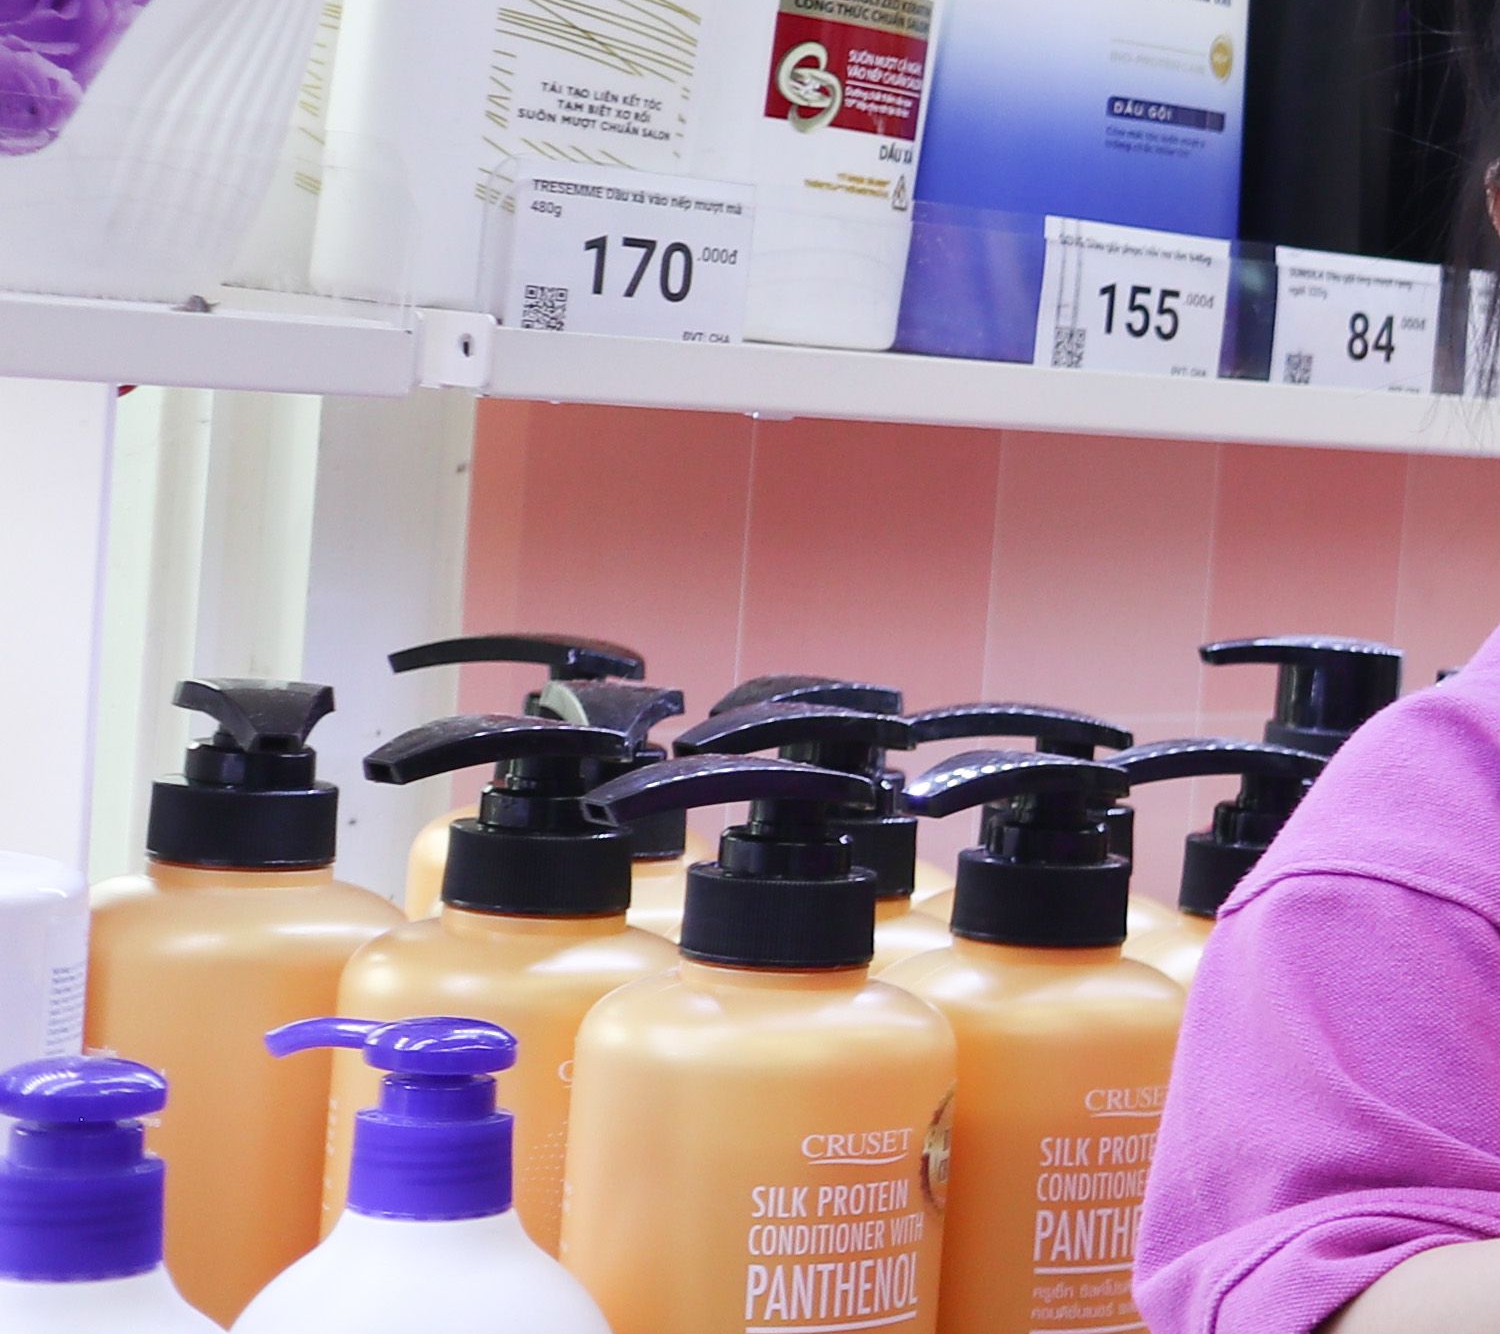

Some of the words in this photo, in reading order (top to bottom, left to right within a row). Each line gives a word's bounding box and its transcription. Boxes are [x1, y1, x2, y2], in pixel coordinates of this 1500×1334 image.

[540, 80, 563, 95] TÁI
[593, 89, 619, 105] LIÊN
[621, 93, 642, 109] KẾT
[642, 96, 663, 112] TÓC
[516, 105, 557, 125] SUÔN
[599, 118, 641, 138] CHUẨN
[640, 127, 672, 142] SALON
[532, 178, 605, 199] TRESEMME
[530, 199, 563, 219] 480g
[582, 233, 694, 303] 170
[696, 245, 739, 266] .000đ
[1098, 282, 1181, 342] 155
[1345, 310, 1396, 364] 84
[801, 1127, 913, 1160] CRUSET
[1039, 1137, 1093, 1169] SILK
[751, 1184, 809, 1220] SILK
[817, 1177, 910, 1218] PROTEIN
[747, 1219, 885, 1257] CONDITIONER
[889, 1210, 925, 1247] WITH
[744, 1250, 920, 1322] PANTHENOL
